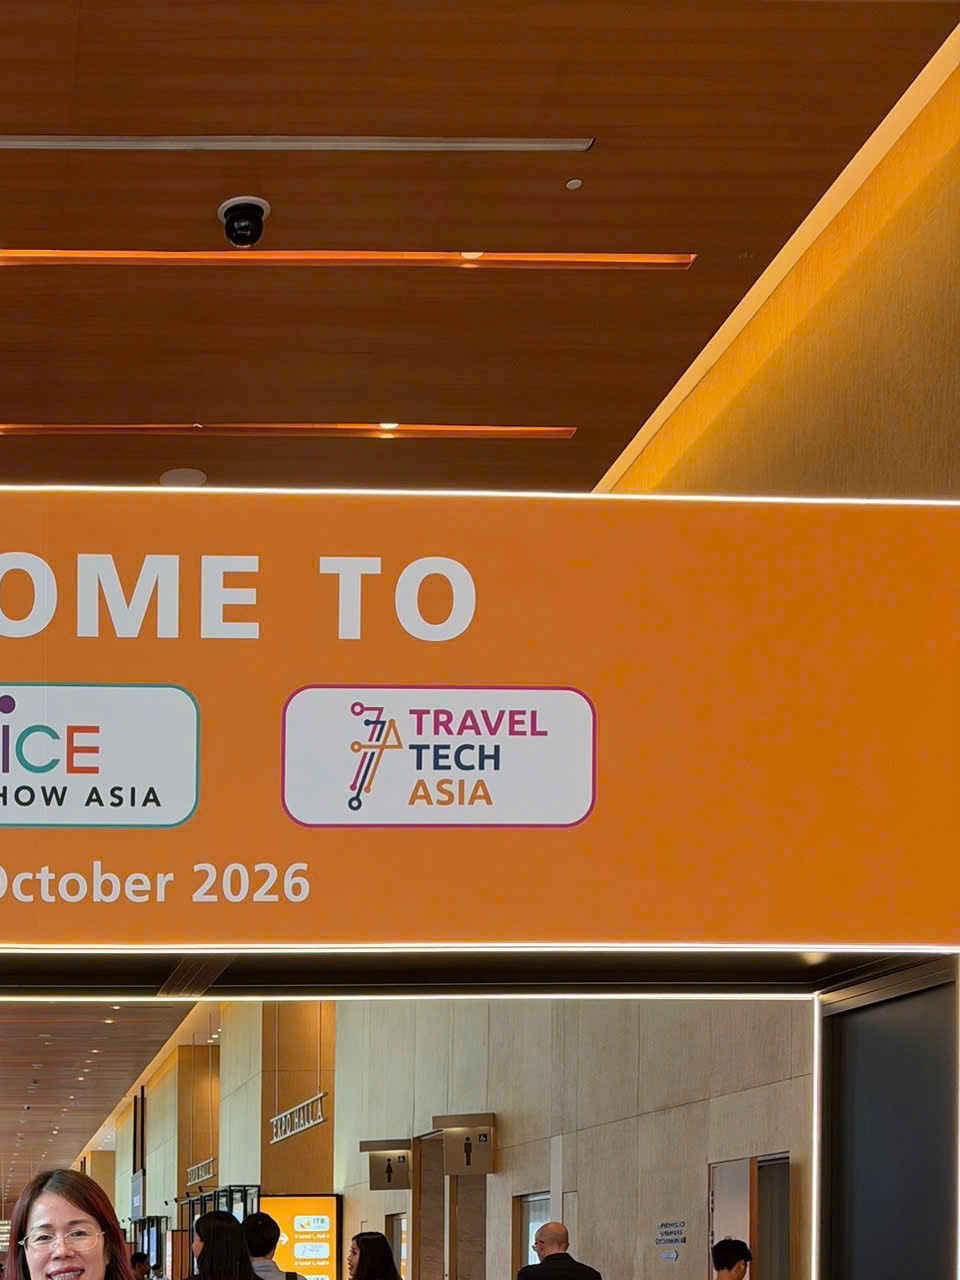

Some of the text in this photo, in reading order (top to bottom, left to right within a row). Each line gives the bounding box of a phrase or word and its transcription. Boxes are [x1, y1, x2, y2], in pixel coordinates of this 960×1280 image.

[319, 556, 477, 642] TO
[409, 708, 548, 737] TRAVEL
[409, 744, 501, 771] TECH
[84, 785, 162, 808] ASIA
[407, 778, 493, 807] ASIA
[192, 863, 311, 903] 2026
[272, 1113, 291, 1141] EXPO
[294, 1102, 313, 1130] HALL
